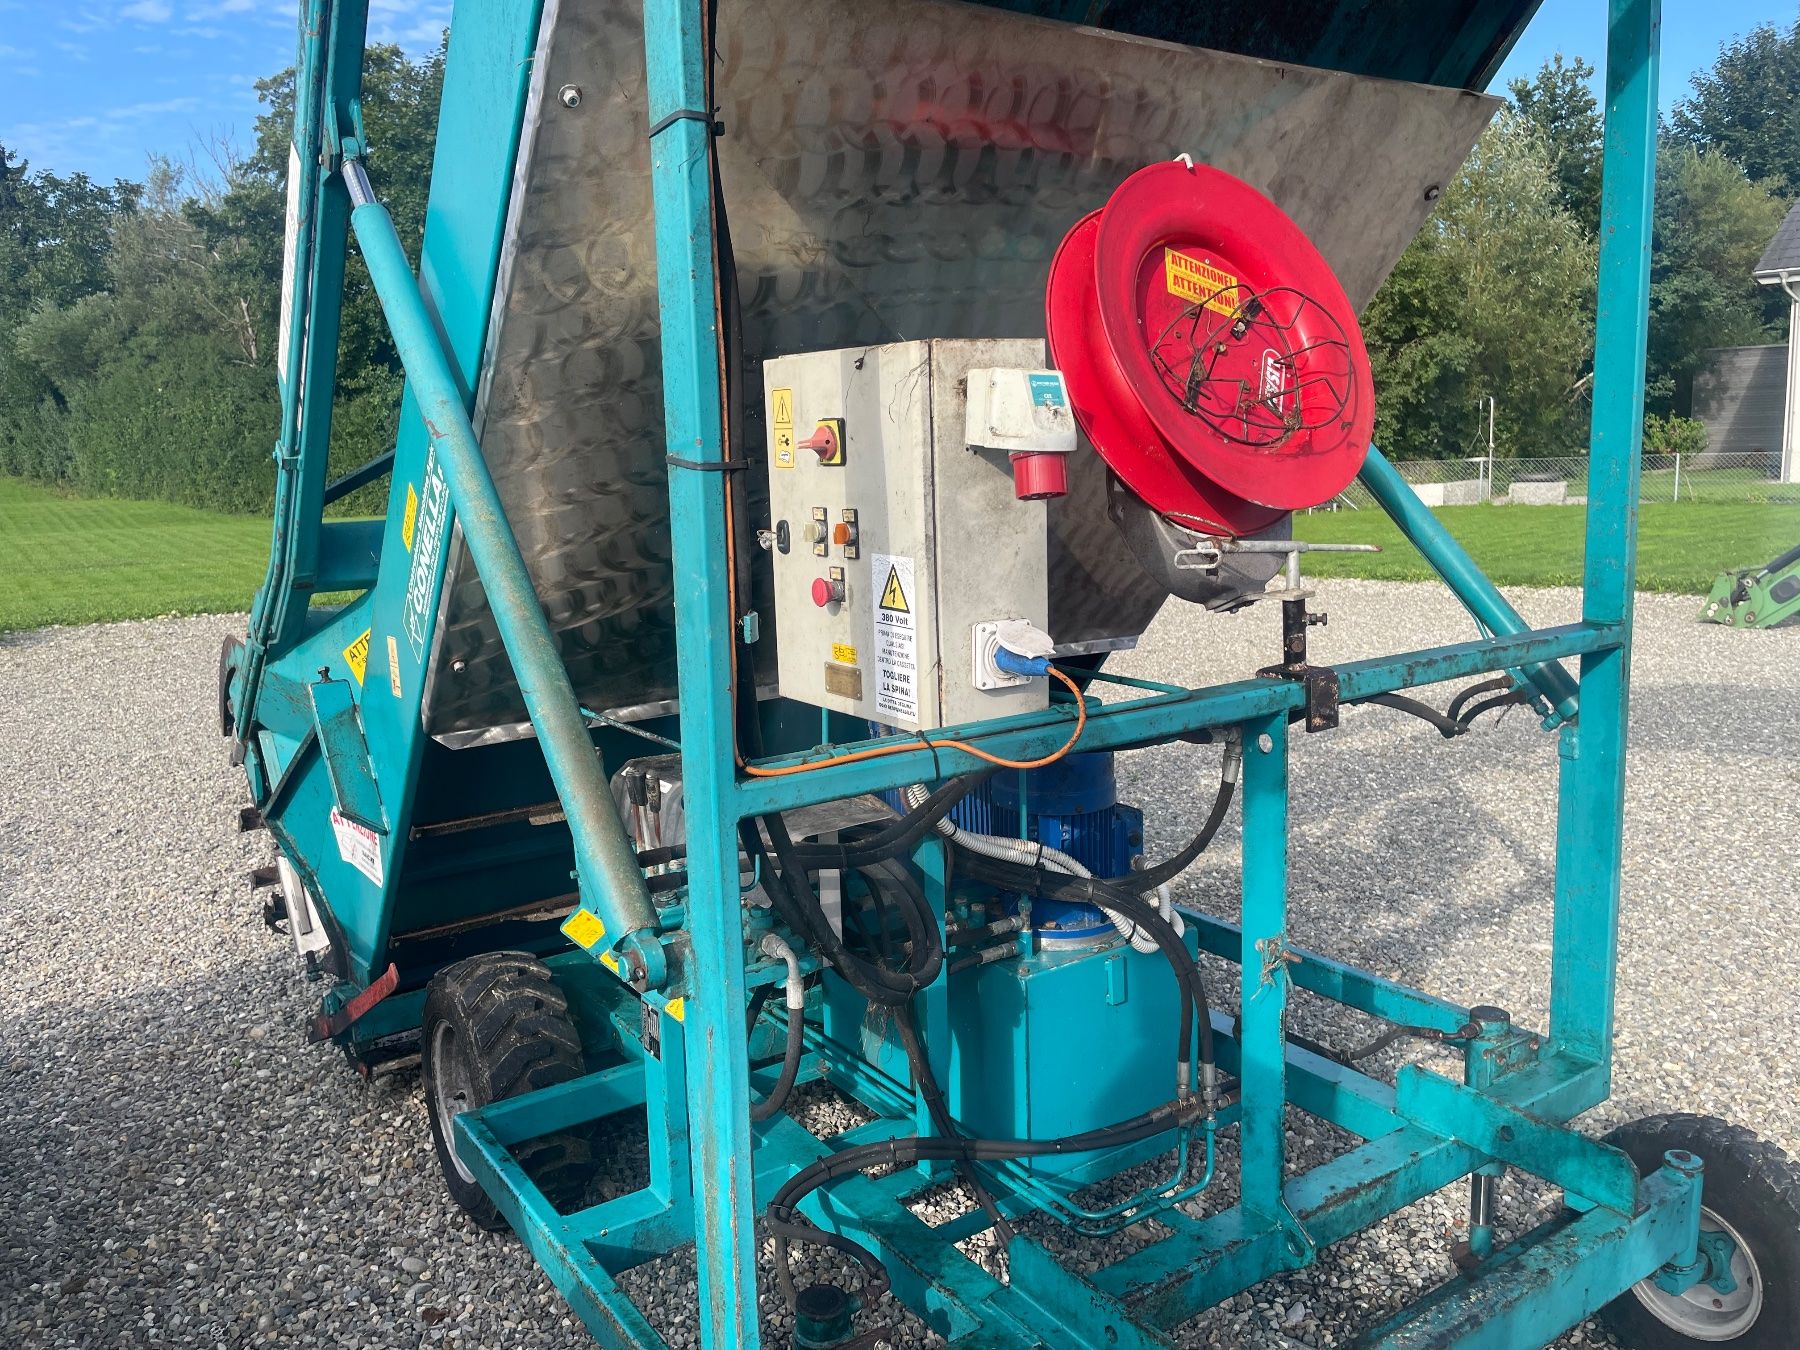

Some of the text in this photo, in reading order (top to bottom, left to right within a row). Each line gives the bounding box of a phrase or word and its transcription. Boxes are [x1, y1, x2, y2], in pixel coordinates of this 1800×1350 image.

[1171, 253, 1233, 287] ATTENZIONE!
[1173, 273, 1236, 310] ATTENTION!
[413, 473, 442, 614] GONELLA
[881, 613, 909, 626] 380 Volt
[882, 669, 911, 684] TOGLIERE
[882, 682, 911, 697] LA SPINA!
